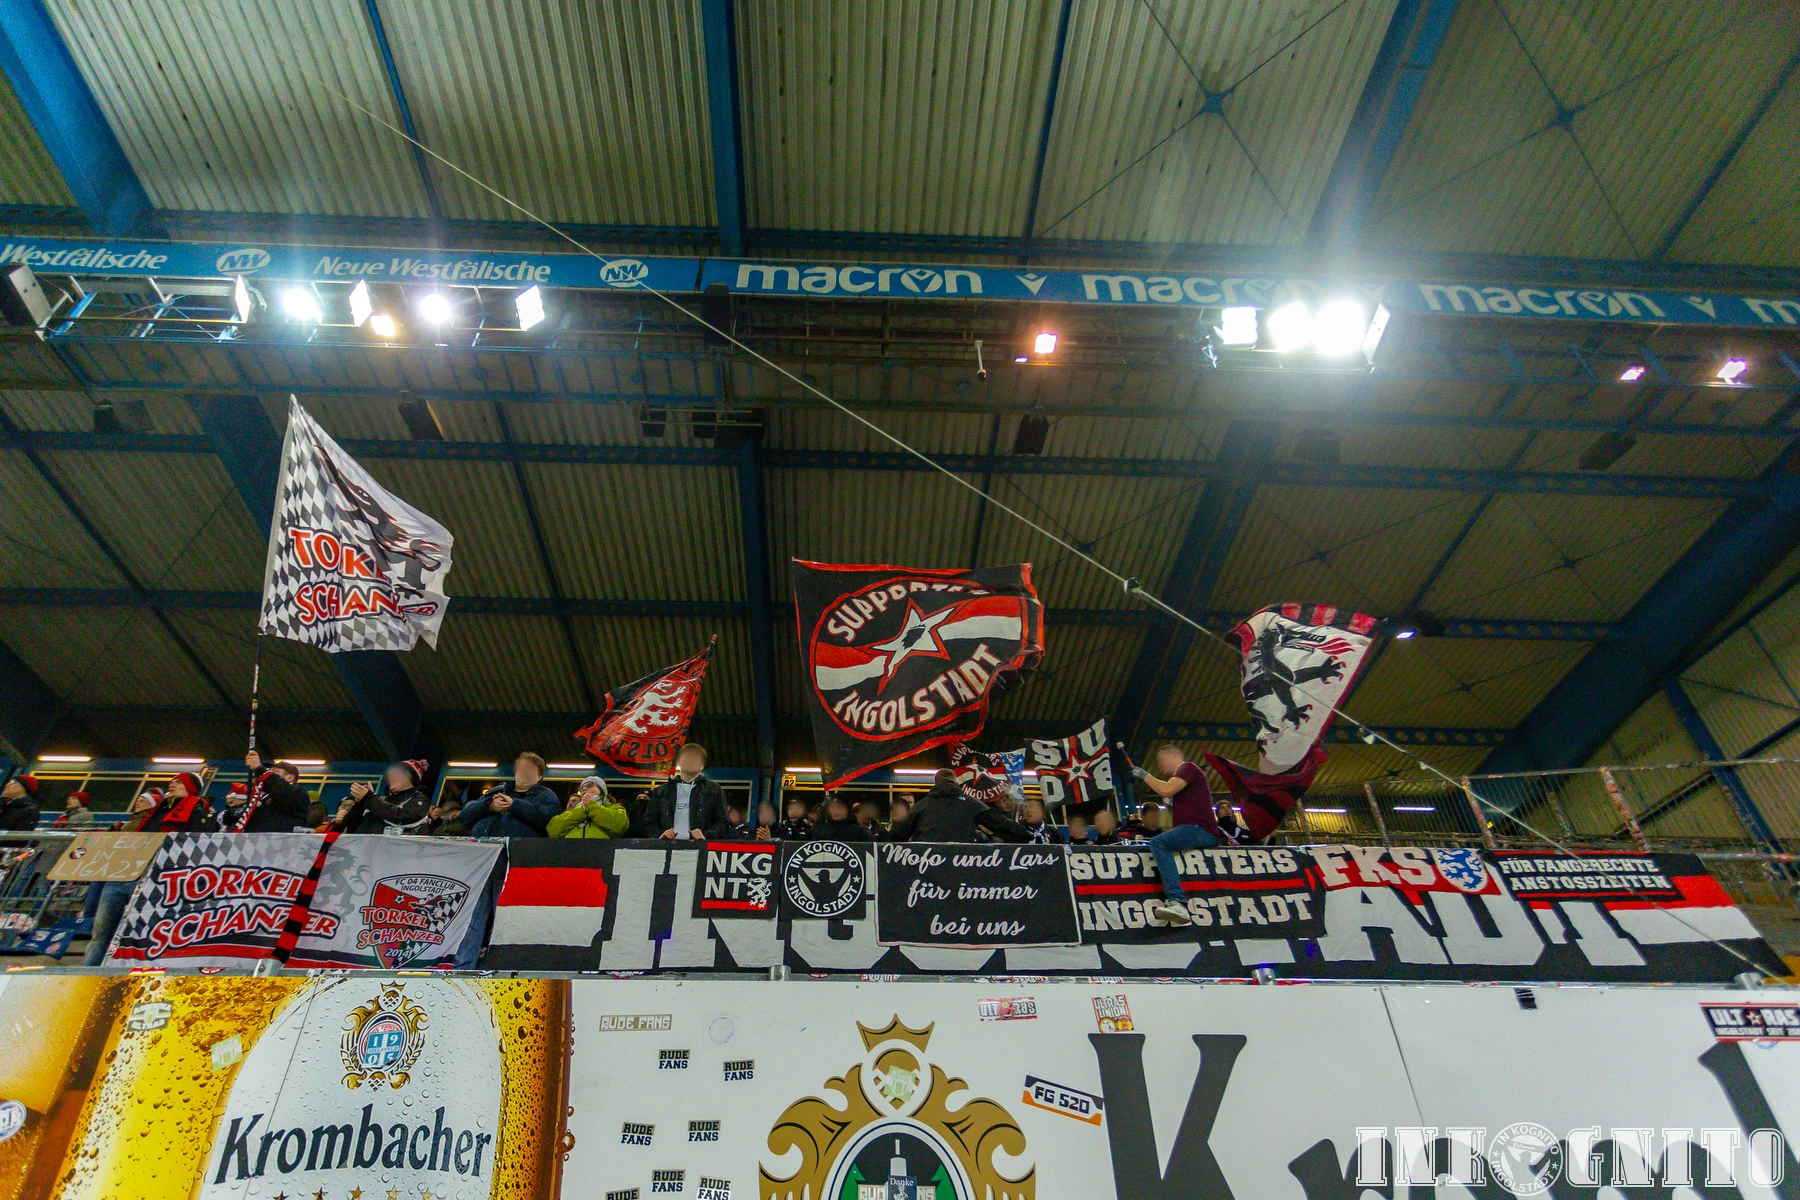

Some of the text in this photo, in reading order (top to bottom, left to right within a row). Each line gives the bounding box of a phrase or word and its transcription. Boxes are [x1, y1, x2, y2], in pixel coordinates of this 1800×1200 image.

[0, 244, 168, 269] Westfälische
[221, 253, 267, 270] NW
[313, 256, 551, 282] Neue Westfälische
[604, 263, 645, 280] NW
[736, 264, 983, 293] macron
[1082, 275, 1321, 302] macron
[1418, 283, 1665, 317] macron
[833, 643, 1002, 732] INGOLSTADT
[92, 851, 115, 861] IN
[706, 851, 772, 876] NKG
[790, 842, 859, 869] IN KOGNITO
[882, 843, 1059, 874] Mofo und Lars
[1309, 846, 1437, 887] FKS
[1498, 858, 1660, 875] FÜR FANGERECHTE
[158, 869, 304, 906] TORKEL
[400, 885, 446, 894] INGOLSTADT
[419, 879, 456, 890] FANCLUB
[1510, 875, 1672, 891] ANSTOSSZEITEN
[788, 885, 859, 913] INGOLSTADT
[907, 879, 1038, 908] für immer
[360, 907, 428, 928] TORKEL
[1078, 893, 1312, 931] INGOSTADT
[930, 915, 1026, 936] bei uns
[357, 929, 444, 949] SCHANZER
[1093, 996, 1126, 1010] ULTRAS
[601, 1015, 670, 1030] RUDE FANS
[659, 1050, 689, 1059] RUDE
[658, 1060, 688, 1069] FANS
[724, 1060, 753, 1071] RUDE
[724, 1071, 753, 1081] FANS
[1034, 1086, 1090, 1114] FG 520
[622, 1123, 653, 1135] RUDE
[689, 1121, 720, 1131] RUDE
[213, 1103, 491, 1185] Krombacher
[621, 1134, 652, 1146] FANS
[688, 1131, 719, 1141] FANS
[653, 1171, 684, 1181] RUDE
[700, 1178, 731, 1190] RUDE
[890, 1177, 914, 1187] Danke
[652, 1182, 683, 1192] FANS
[698, 1189, 729, 1200] FANS
